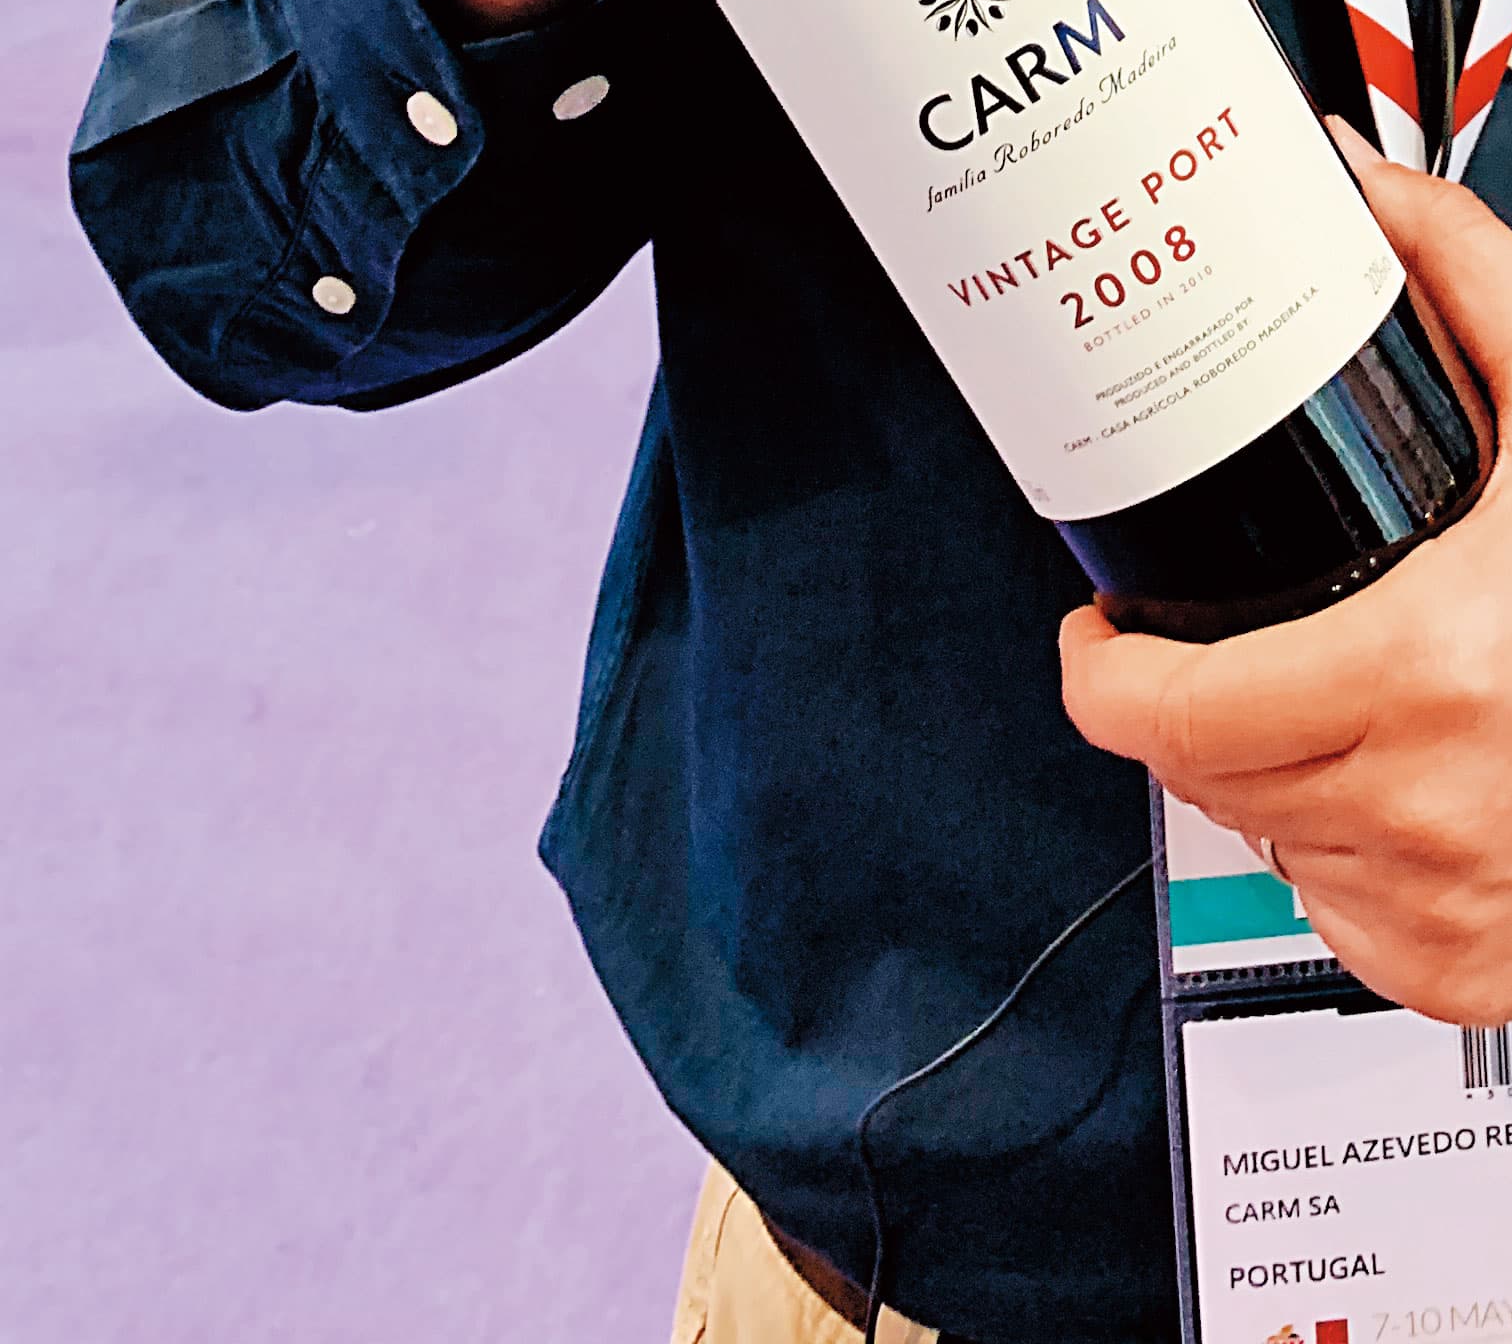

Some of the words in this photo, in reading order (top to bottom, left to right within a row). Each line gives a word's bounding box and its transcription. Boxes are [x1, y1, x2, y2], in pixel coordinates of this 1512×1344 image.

[927, 168, 986, 212] familia
[994, 97, 1095, 173] Roboredo
[1099, 36, 1177, 103] Madeira
[947, 198, 1132, 307] VINTAGE
[1140, 107, 1240, 205] PORT
[1060, 225, 1196, 329] 2008
[1083, 308, 1151, 352] BOTTLED
[1157, 292, 1175, 309] IN
[1179, 265, 1213, 294] 2010
[1101, 419, 1131, 439] CASA
[1193, 339, 1257, 389] ROBOREDO
[1258, 301, 1303, 343] MADEIRA
[1169, 360, 1192, 378] AND
[1193, 327, 1236, 363] BOTTLED
[1222, 1143, 1334, 1176] MIGUEL
[1342, 1128, 1476, 1165] AZEVEDO
[1225, 1198, 1300, 1224] CARM
[1308, 1194, 1341, 1217] SA
[1229, 1252, 1386, 1290] PORTUGAL
[1371, 1305, 1442, 1342] 7-10
